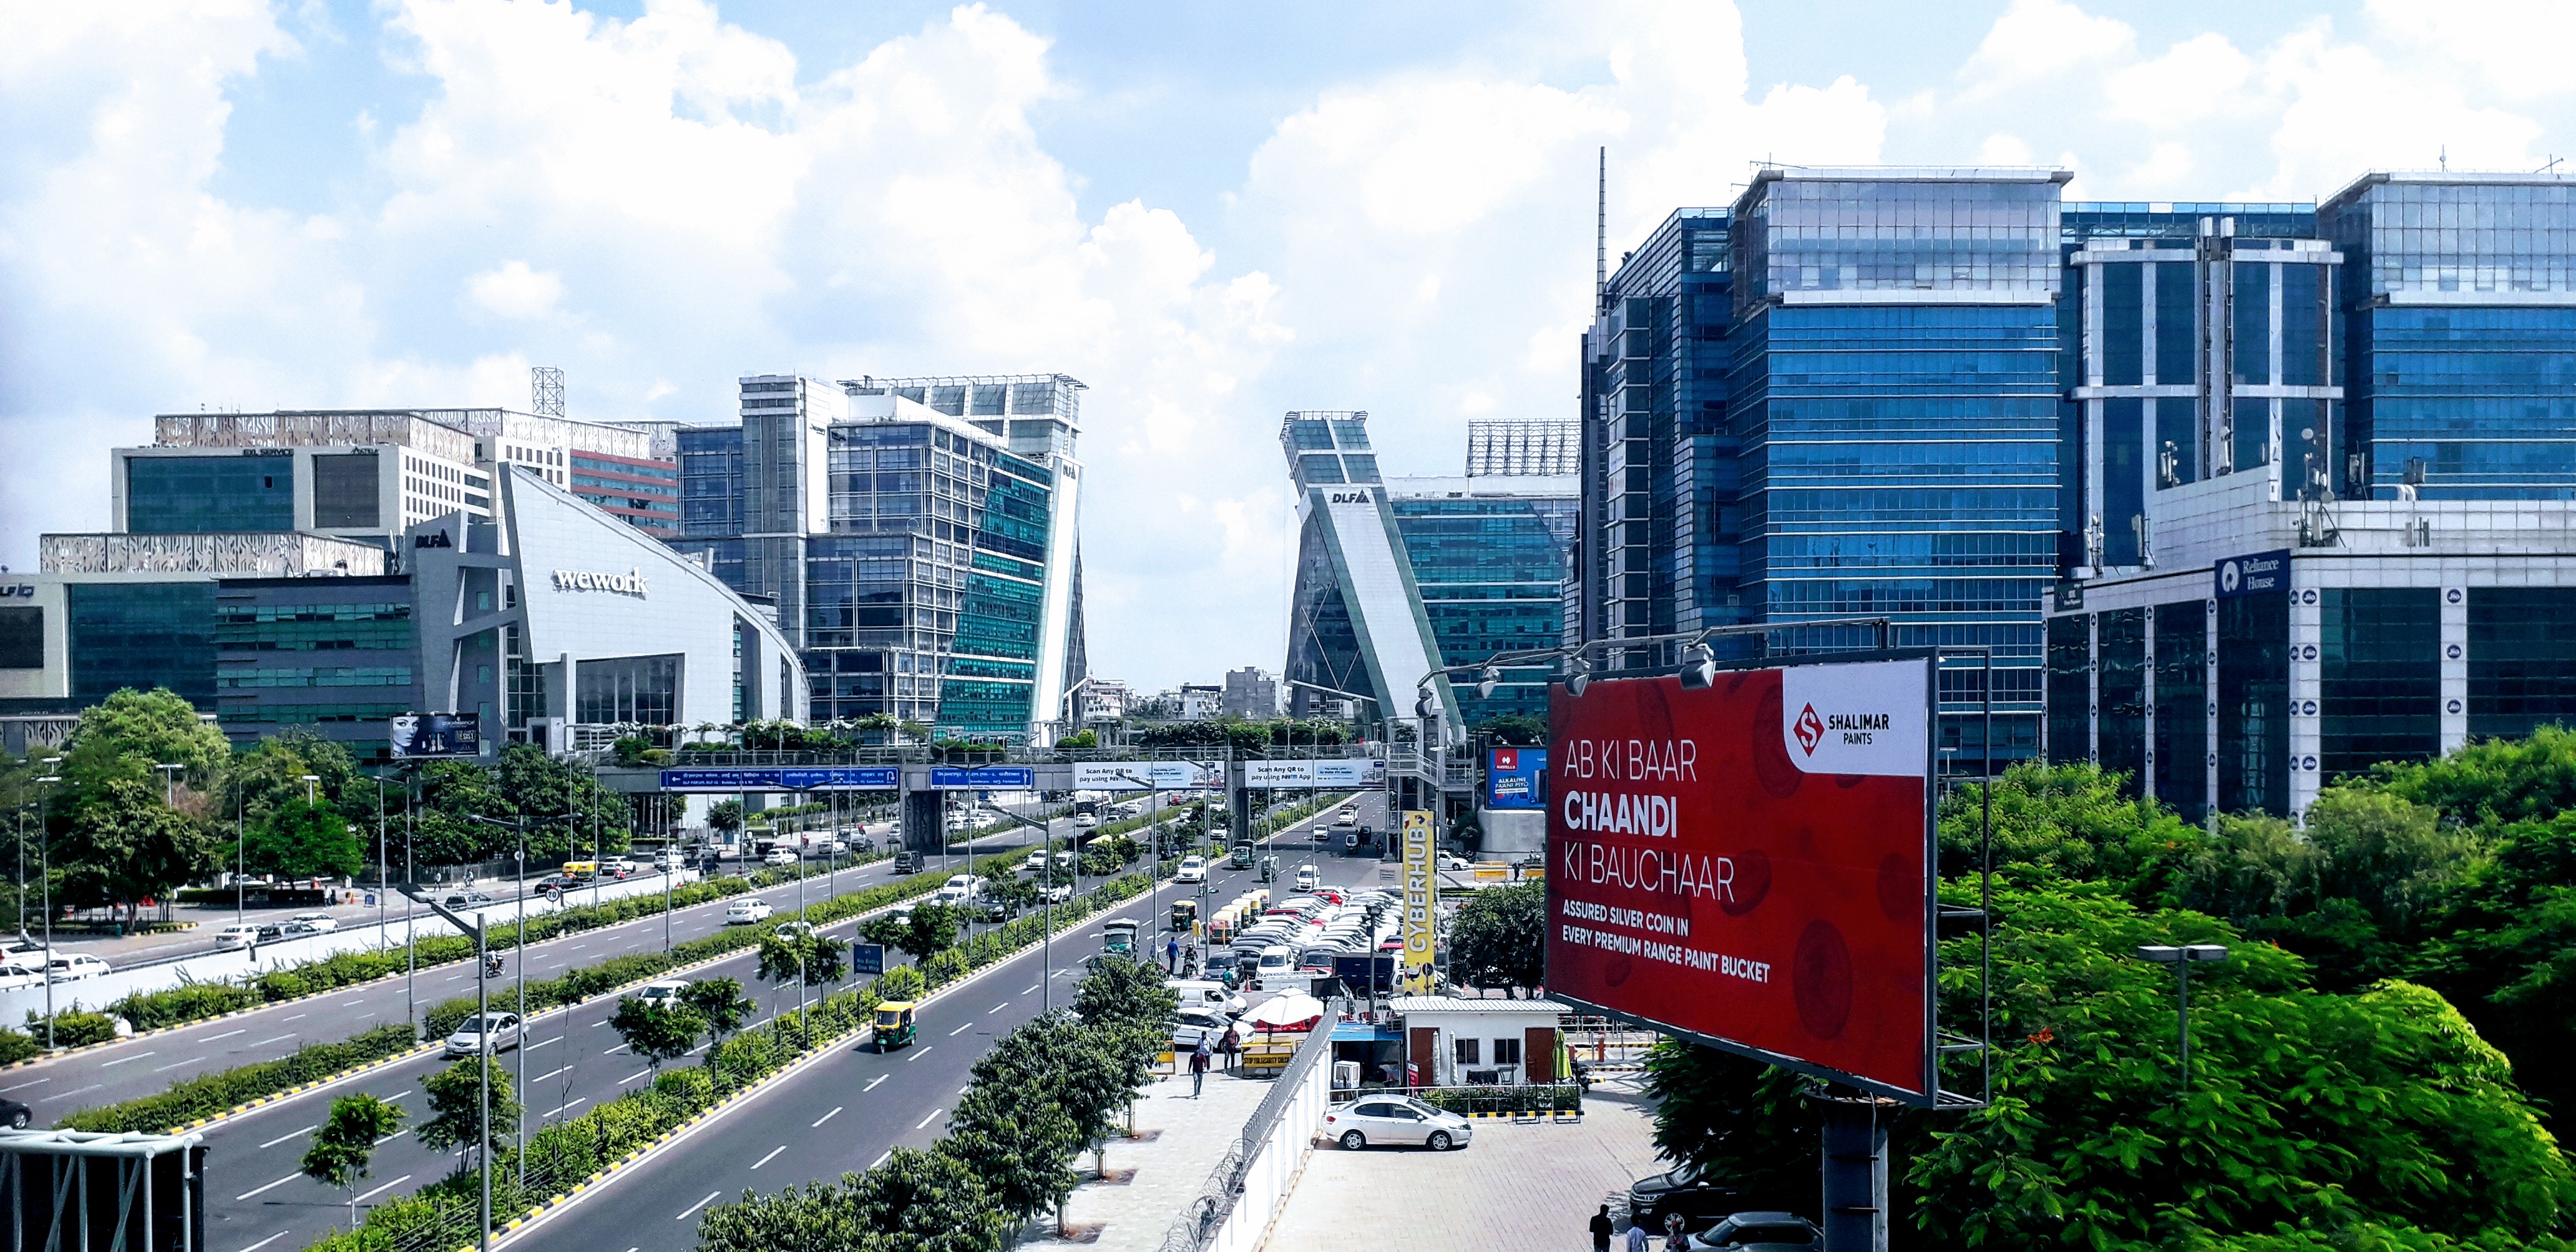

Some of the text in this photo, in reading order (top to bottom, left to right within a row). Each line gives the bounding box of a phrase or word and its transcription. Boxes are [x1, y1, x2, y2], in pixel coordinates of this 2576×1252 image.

[1332, 493, 1357, 503] DLF
[415, 534, 439, 548] DLF
[553, 565, 650, 594] wework
[2243, 558, 2279, 574] Reliance
[2248, 576, 2275, 590] House
[1828, 713, 1890, 730] SHALIMAR
[1843, 732, 1872, 745] PAINTS
[1564, 739, 1697, 782] AB KI BAAR
[1564, 790, 1677, 838] CHAANDI
[1564, 841, 1735, 902] KI BAUCHAAR
[1408, 827, 1427, 952] CYBERHUB
[1563, 899, 1689, 937] ASSURED SILVER COIN IN
[1563, 925, 1770, 984] EVERY PREMIUM RANGE PAINT BUCKET
